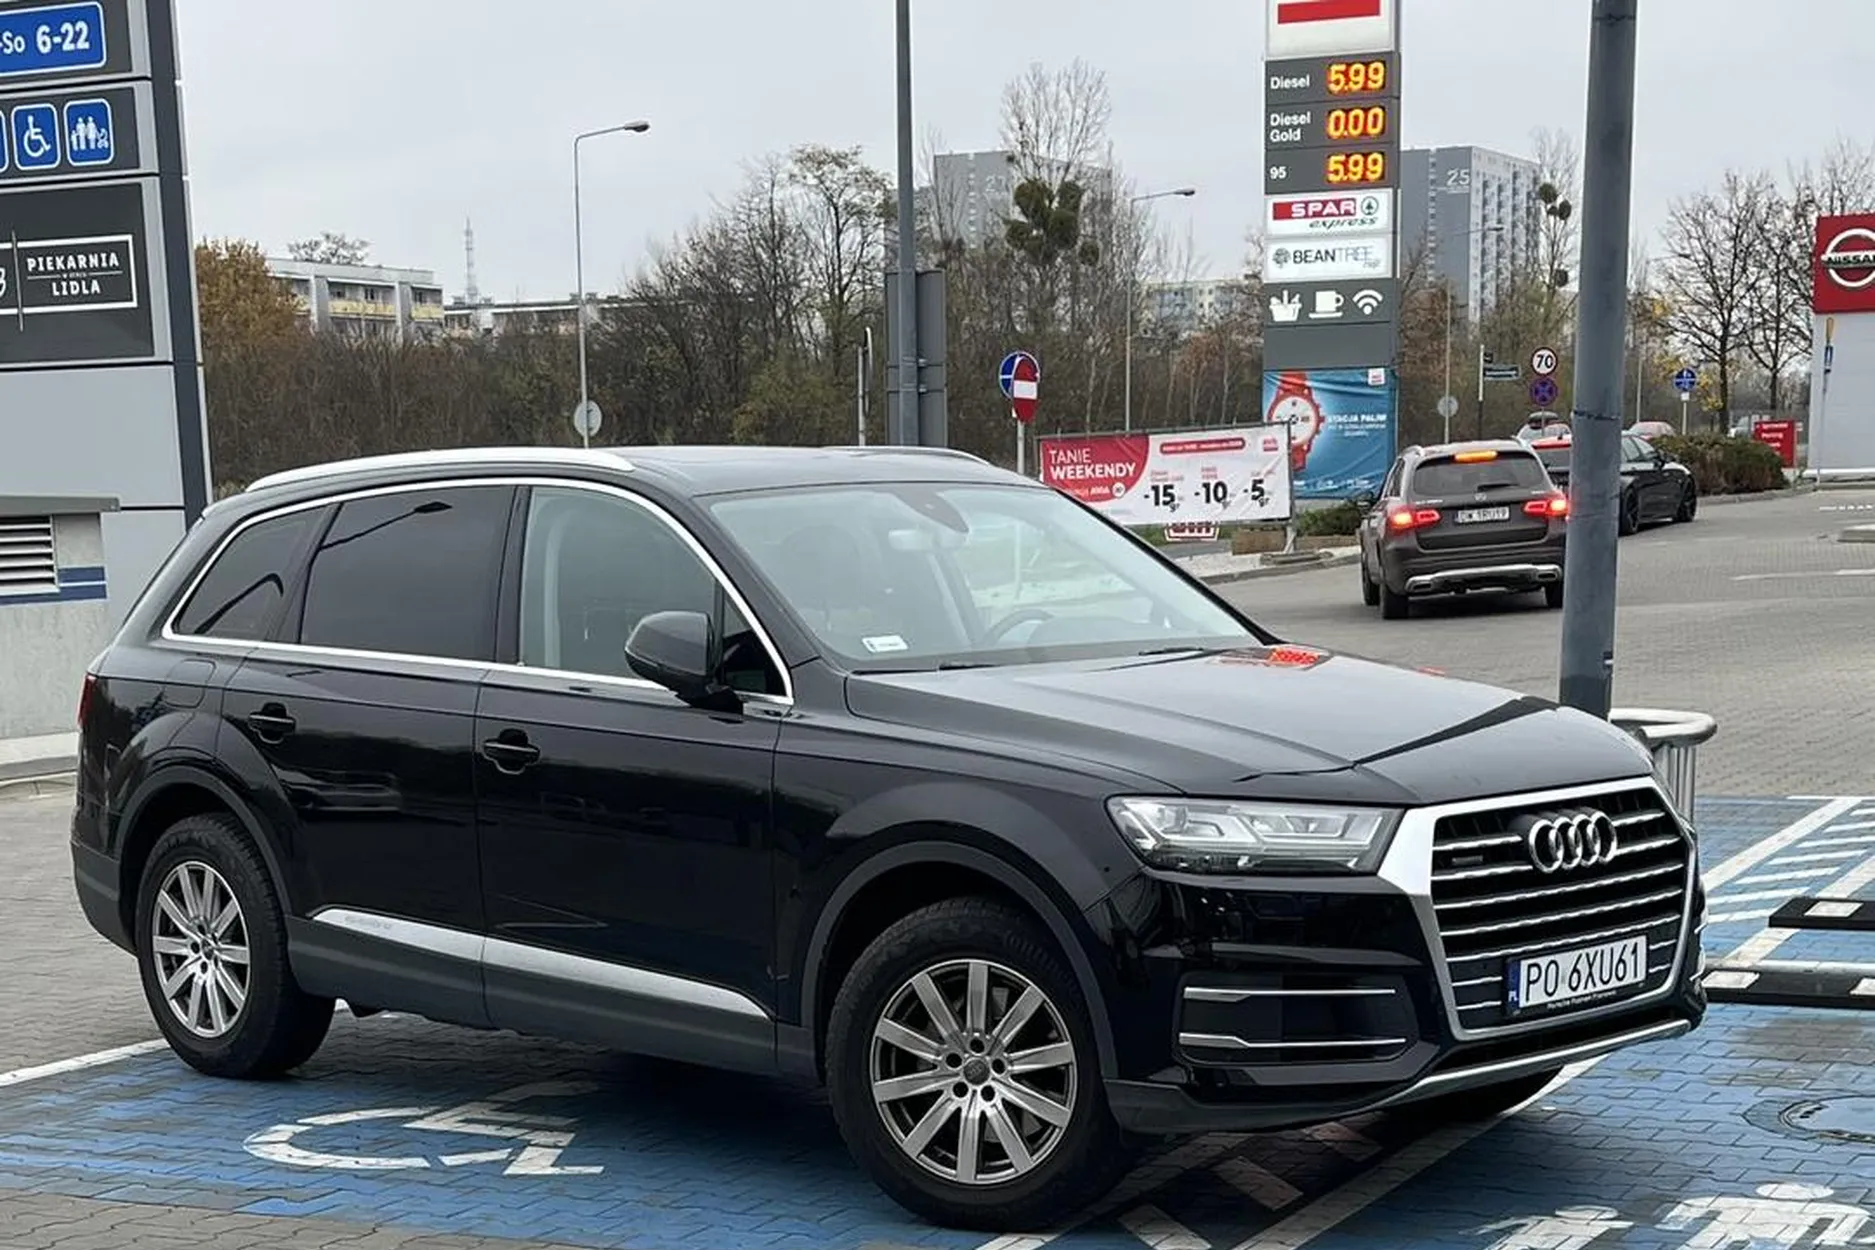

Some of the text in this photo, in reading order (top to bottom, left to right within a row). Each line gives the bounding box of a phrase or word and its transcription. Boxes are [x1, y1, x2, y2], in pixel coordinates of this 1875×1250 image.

[36, 20, 90, 54] 6-22
[1270, 61, 1385, 92] Diesel 5.99
[1270, 112, 1311, 127] Diesel
[1328, 107, 1385, 138] 0.00
[1270, 128, 1301, 143] Gold
[1270, 152, 1384, 182] 95 5.99
[1446, 168, 1470, 186] 25
[1291, 200, 1355, 218] SPAR
[1309, 217, 1378, 230] express
[26, 252, 120, 272] PIEKARNIA
[52, 280, 101, 296] LIDLA
[1537, 354, 1554, 369] 70
[1049, 447, 1093, 465] TANIE
[1050, 462, 1137, 480] WEEKENDY
[1525, 959, 1559, 1003] PO
[1568, 941, 1638, 992] 6XU61
